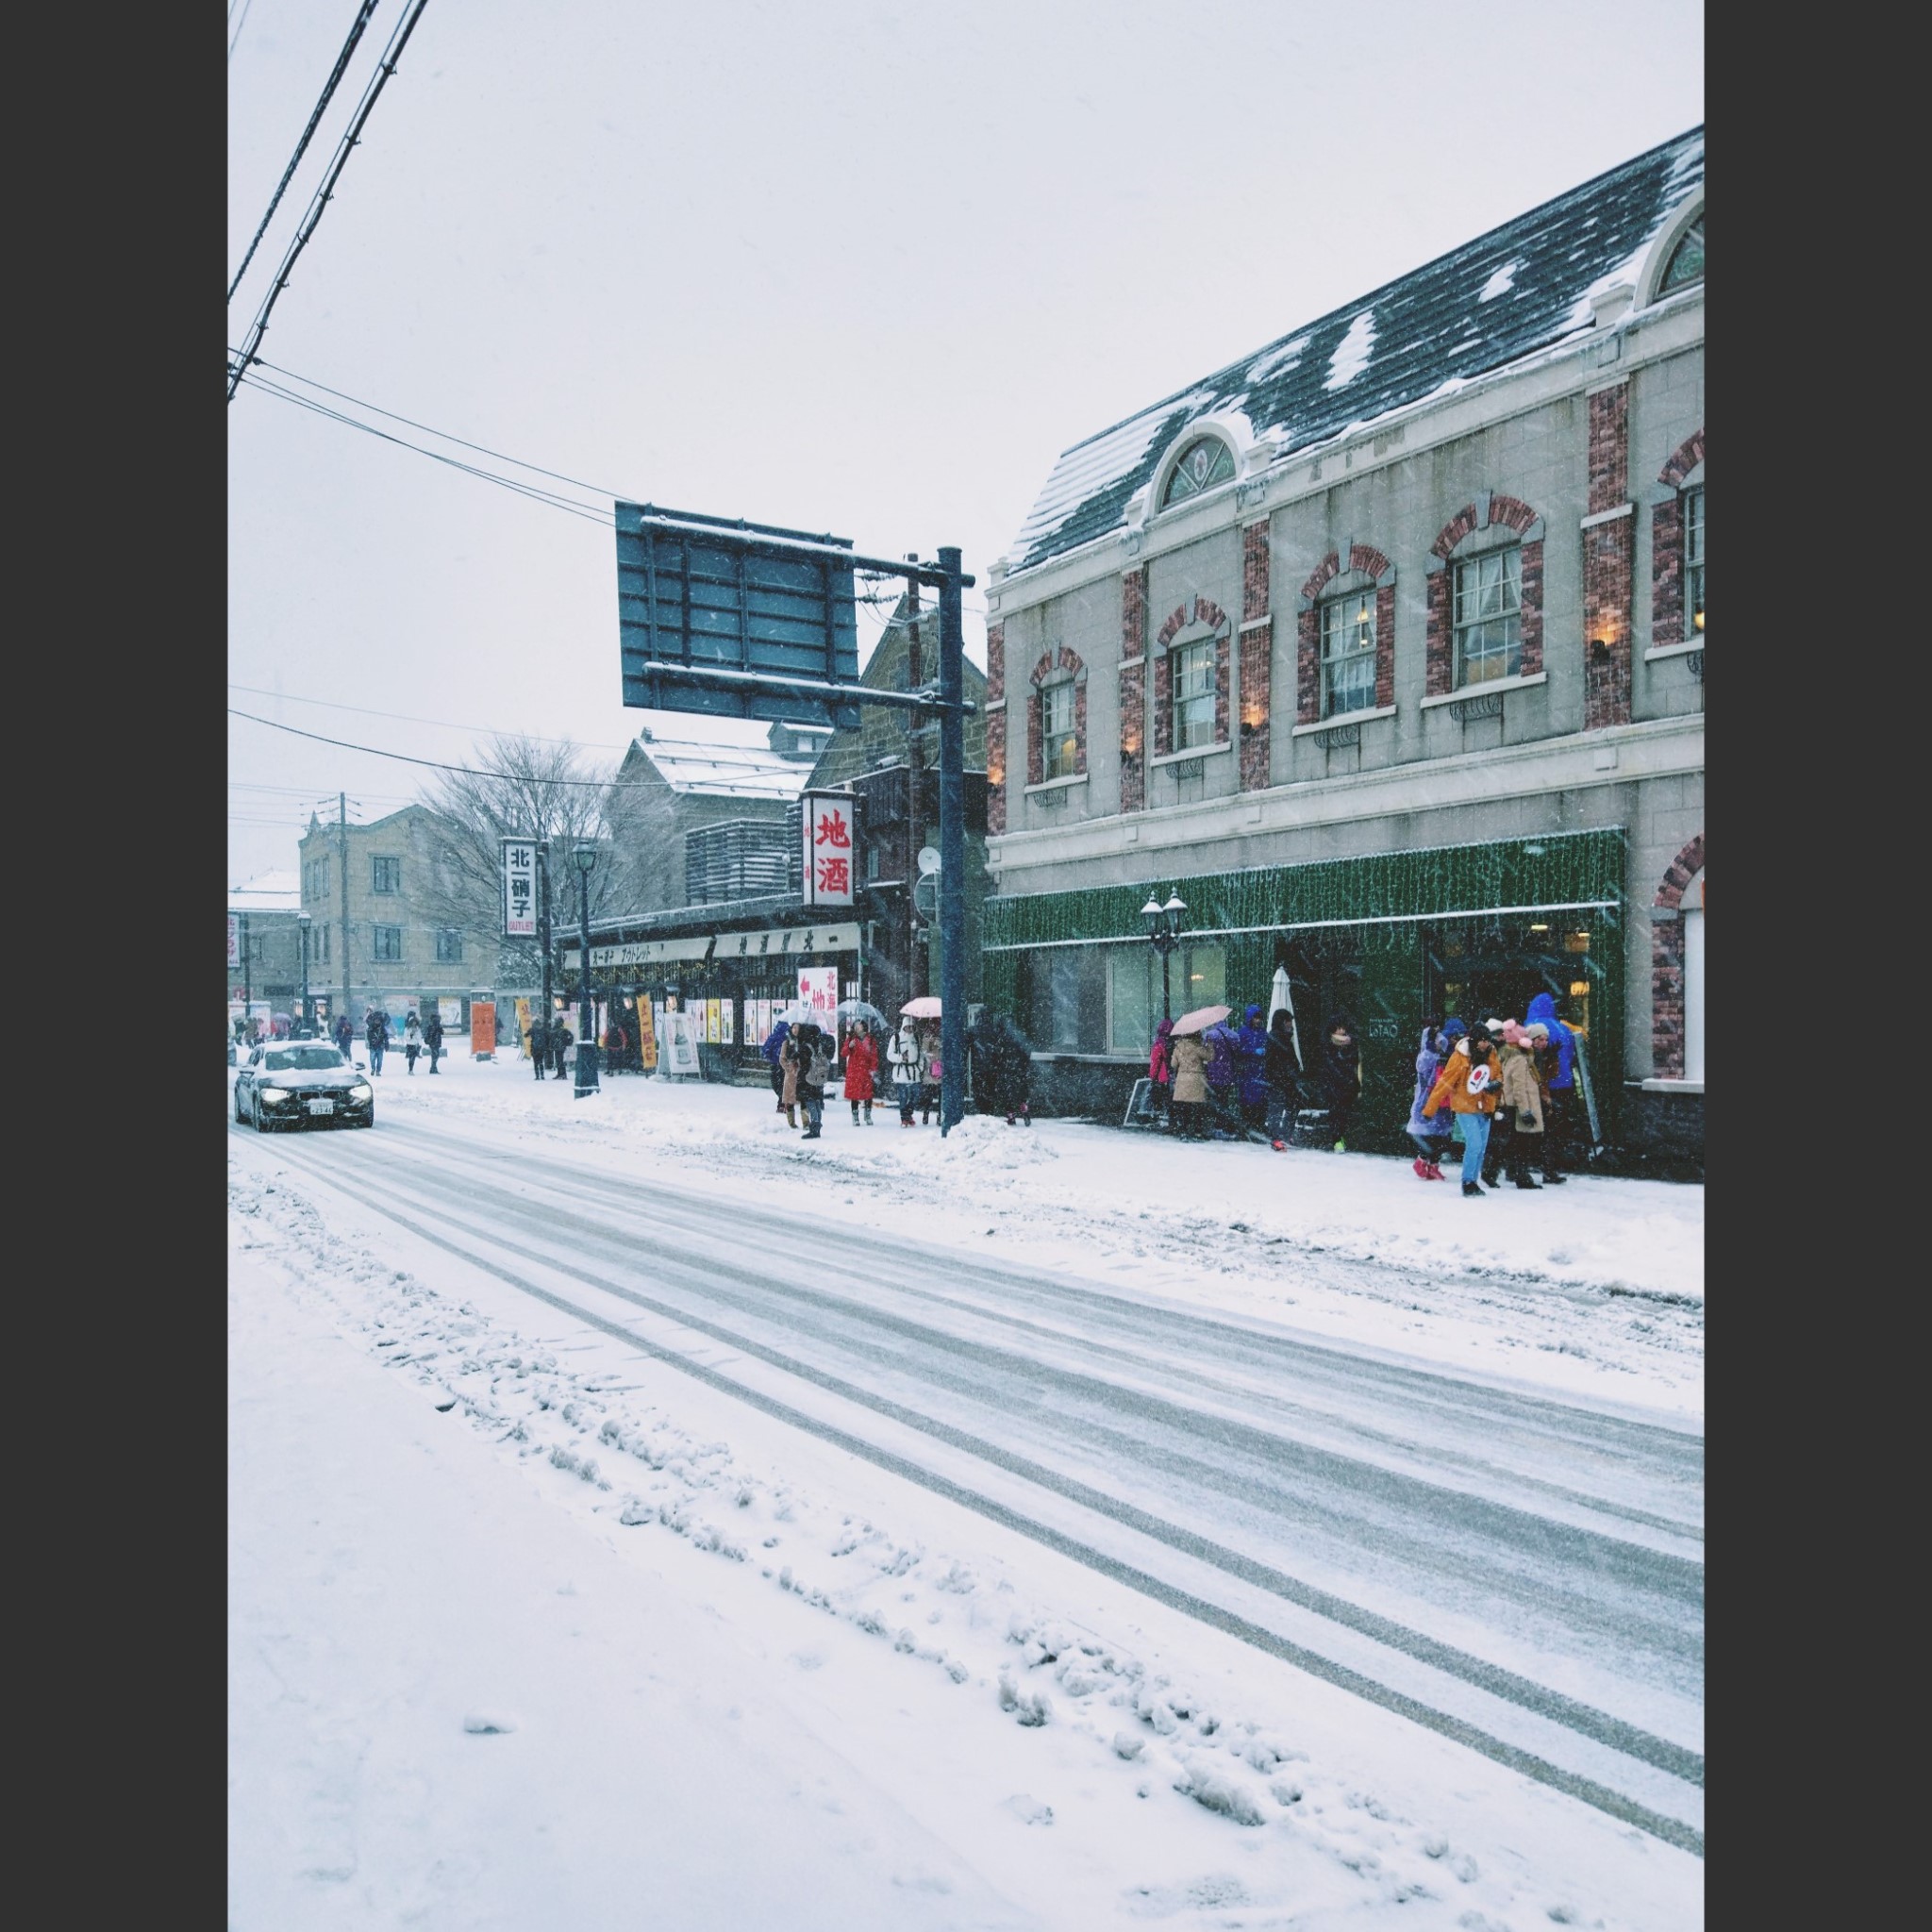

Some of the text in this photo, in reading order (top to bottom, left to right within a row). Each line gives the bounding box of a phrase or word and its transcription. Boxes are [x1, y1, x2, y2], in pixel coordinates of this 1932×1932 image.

[510, 847, 530, 918] 北一硝子
[815, 808, 851, 896] 地酒
[508, 921, 534, 932] OUTLET
